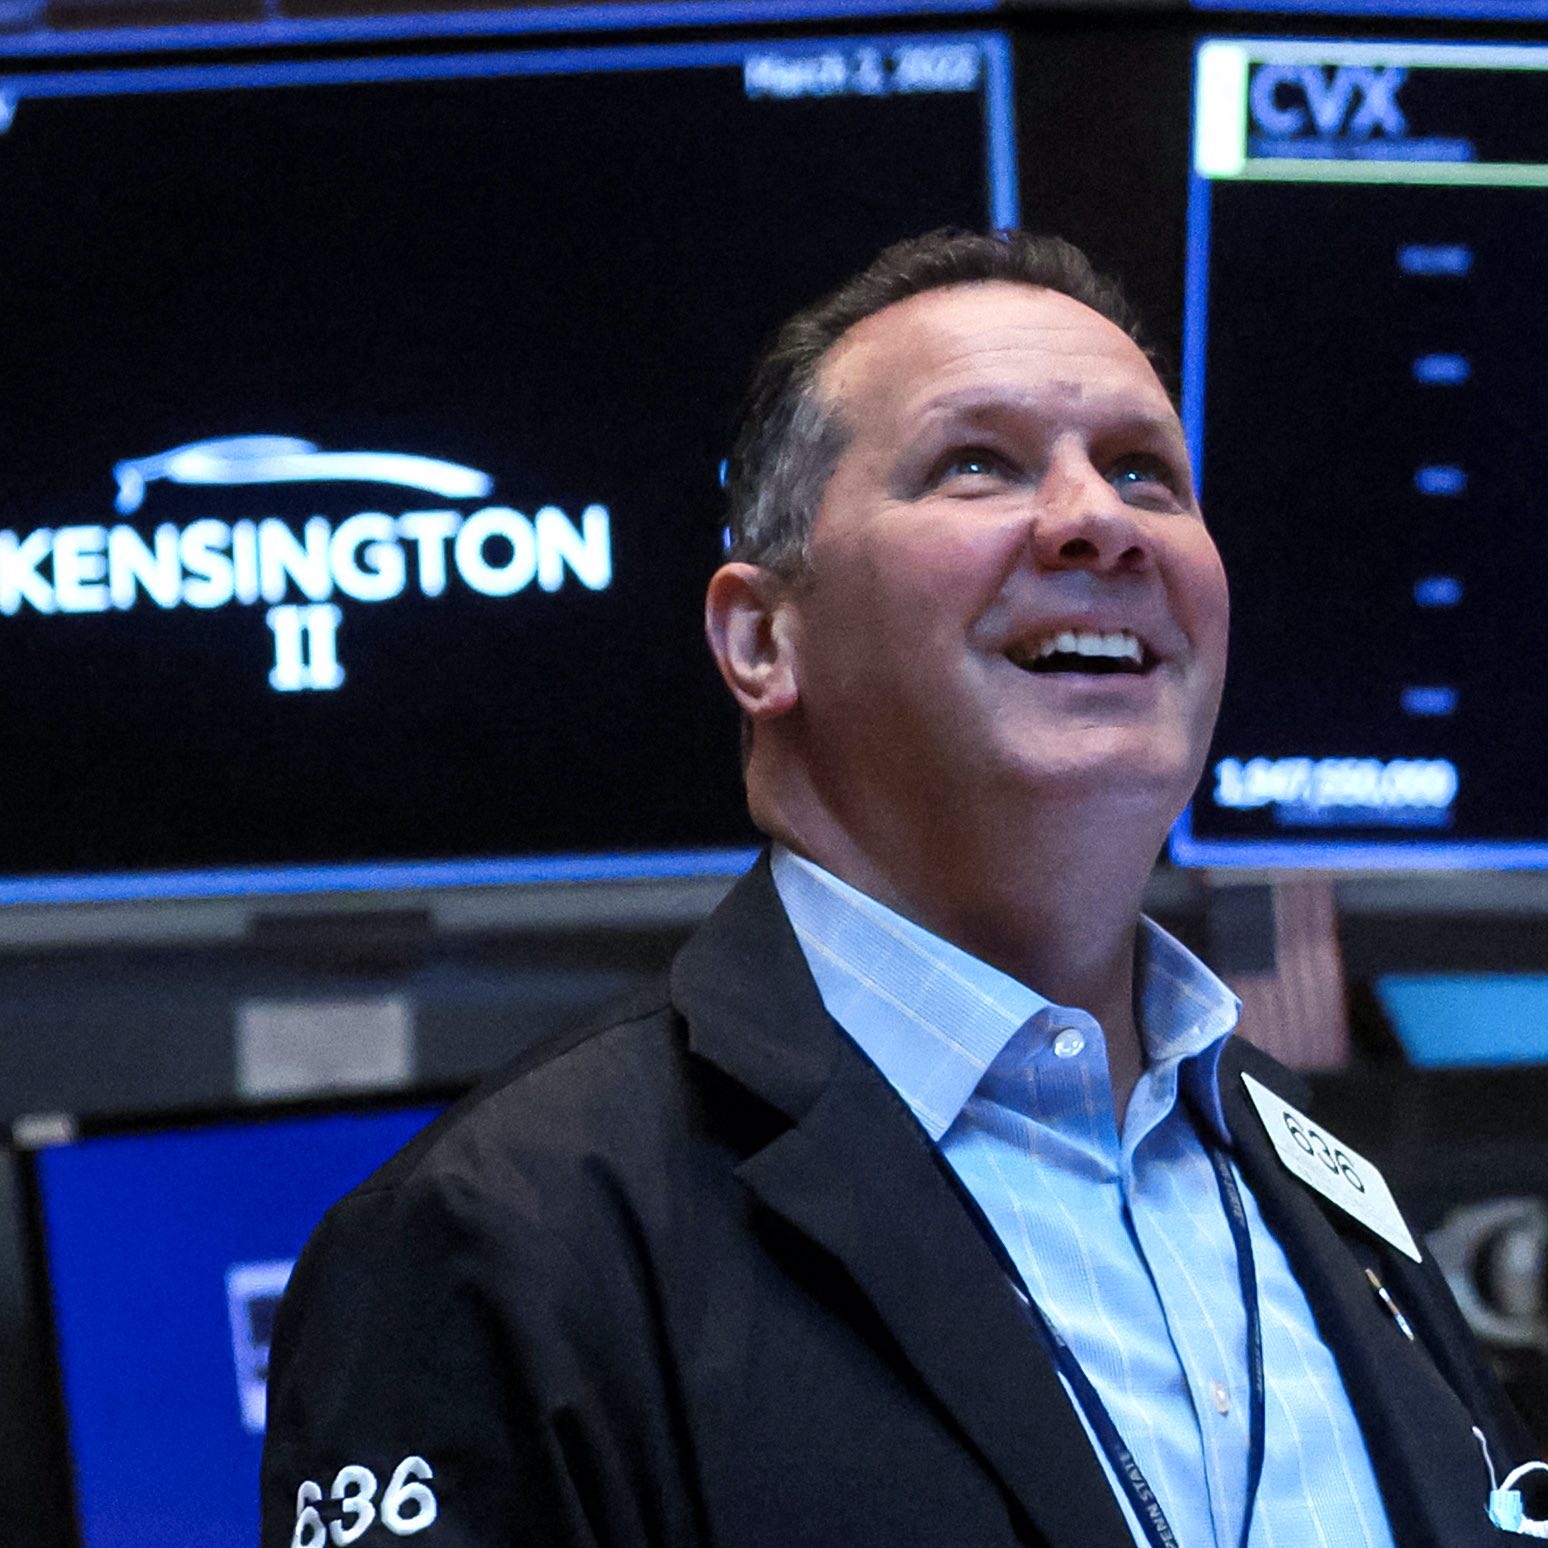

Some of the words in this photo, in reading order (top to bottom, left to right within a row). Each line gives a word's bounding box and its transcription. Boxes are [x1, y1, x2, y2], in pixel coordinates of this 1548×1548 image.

[1250, 62, 1407, 136] CVX
[0, 504, 612, 616] KENSINGTON
[266, 602, 345, 692] II
[1283, 1112, 1366, 1194] 636
